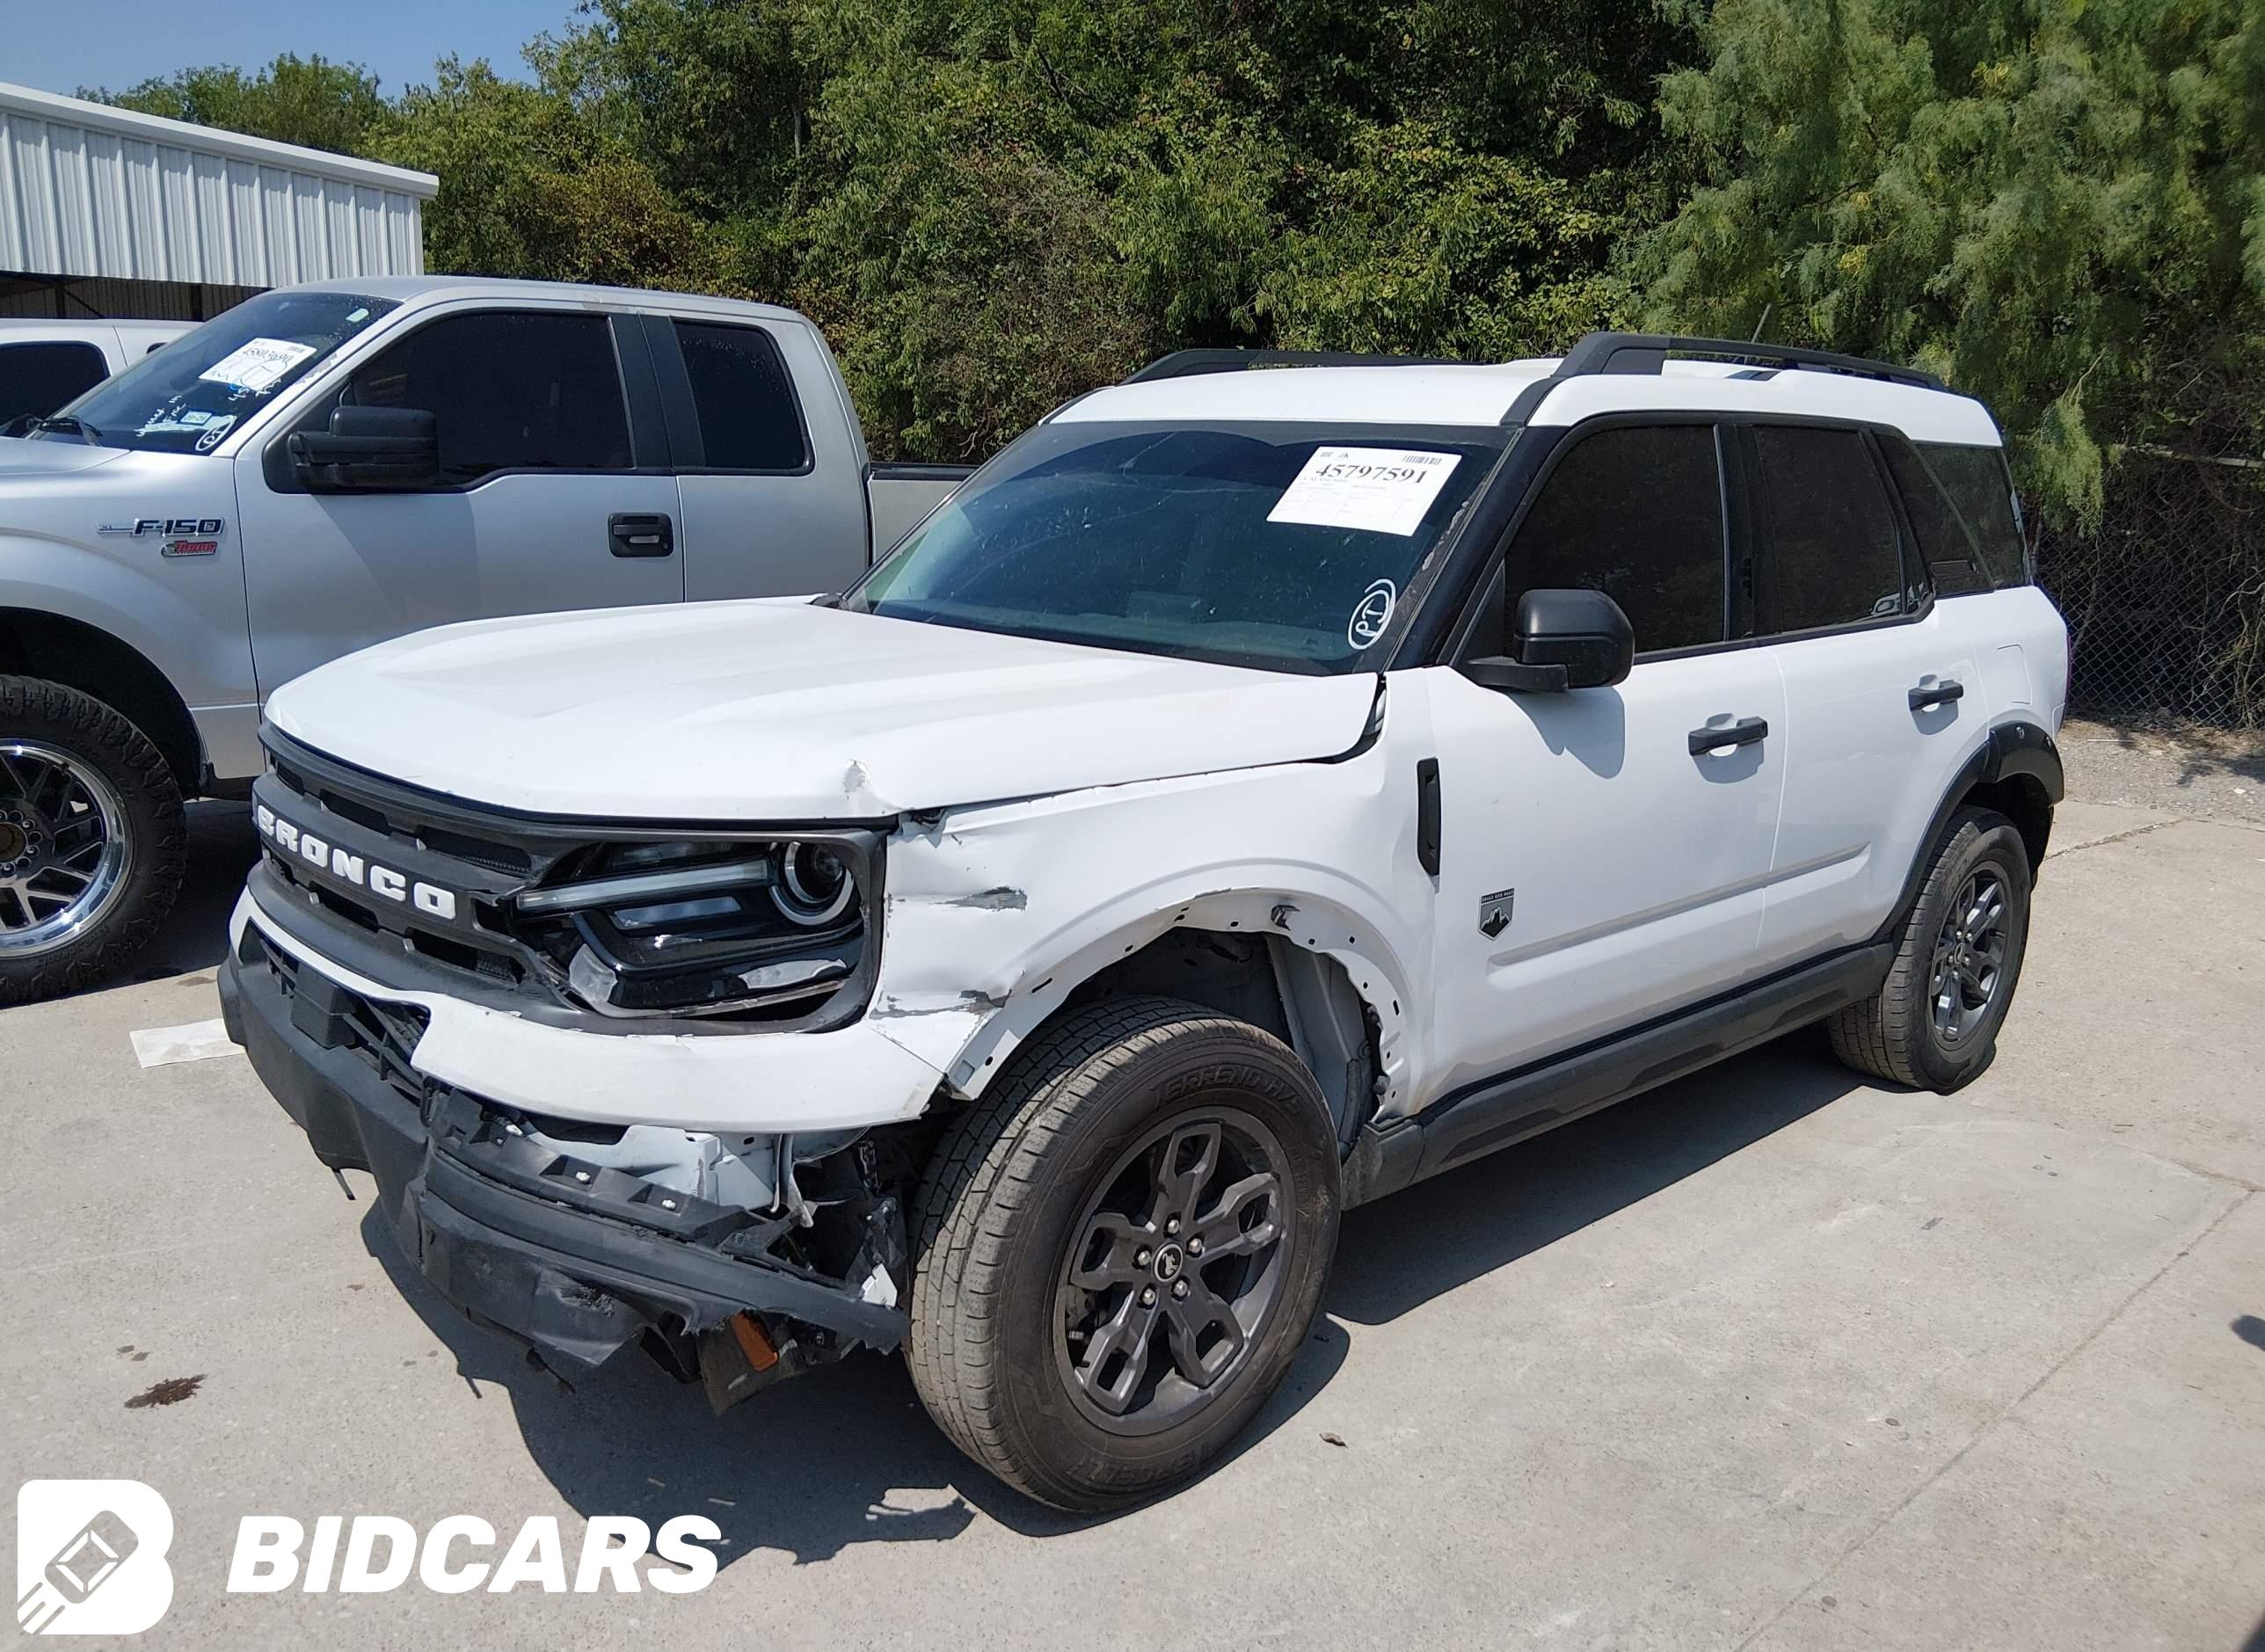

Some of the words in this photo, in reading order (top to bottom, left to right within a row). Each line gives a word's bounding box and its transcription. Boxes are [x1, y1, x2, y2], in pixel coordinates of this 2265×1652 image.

[1315, 463, 1427, 484] 45797591
[133, 518, 223, 535] F-150
[258, 804, 455, 920] BRONCO
